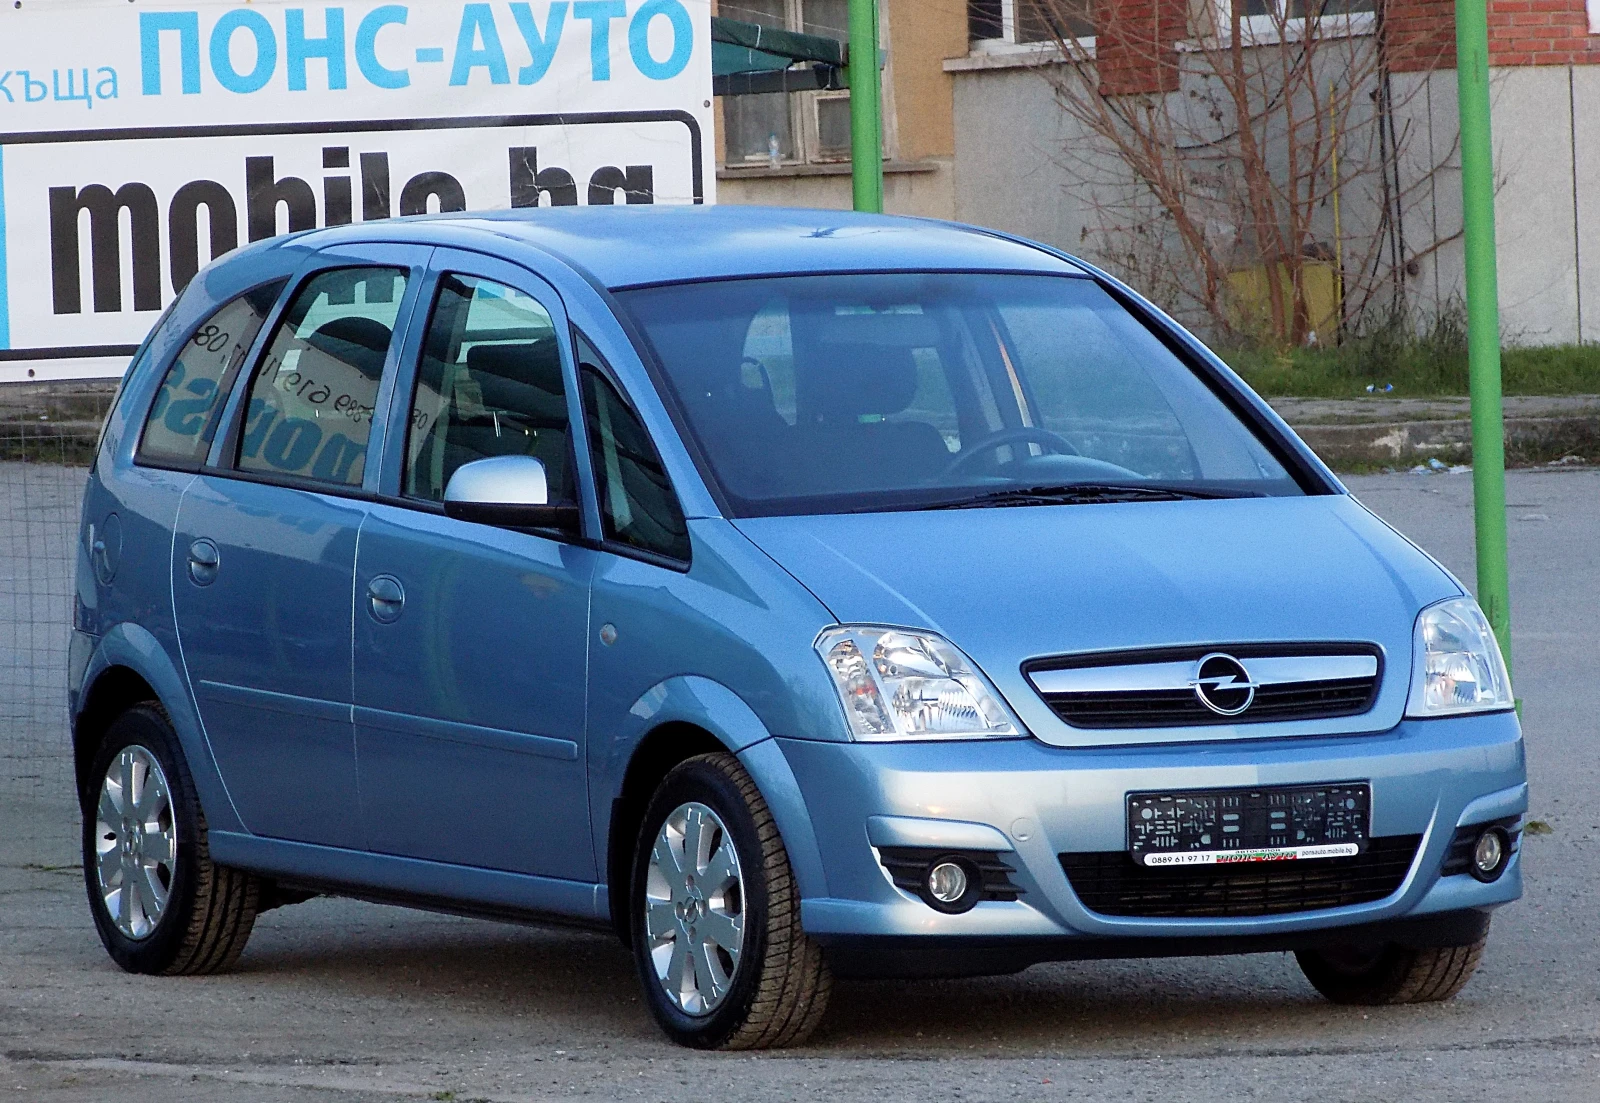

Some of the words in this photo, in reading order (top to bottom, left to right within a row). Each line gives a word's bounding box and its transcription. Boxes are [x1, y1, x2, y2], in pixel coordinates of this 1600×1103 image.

[139, 0, 694, 95] ПОНС-АУТО
[1151, 856, 1173, 864] 0889
[1174, 855, 1185, 863] 61
[1187, 855, 1198, 863] 97
[1201, 854, 1211, 862] 17
